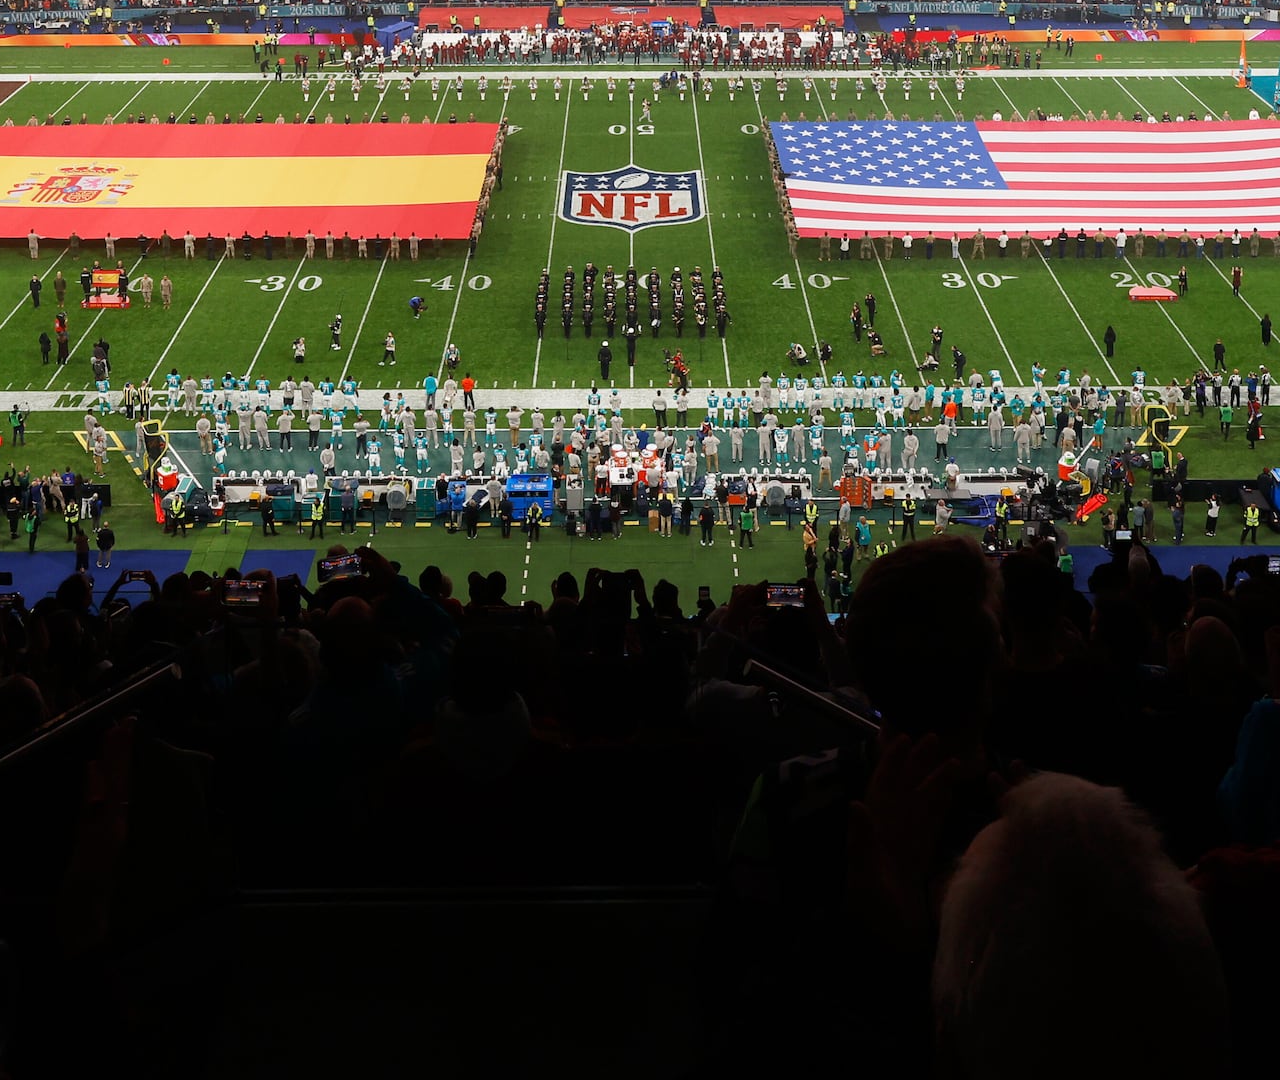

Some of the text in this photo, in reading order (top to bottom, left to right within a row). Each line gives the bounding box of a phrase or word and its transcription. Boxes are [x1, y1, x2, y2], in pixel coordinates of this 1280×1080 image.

[290, 6, 313, 16] 2025
[315, 5, 336, 15] NFL
[894, 3, 912, 12] NFL
[952, 3, 980, 12] GAME
[608, 124, 655, 135] 50
[576, 192, 688, 221] NFL
[260, 275, 323, 292] 30
[430, 275, 493, 291] 40
[771, 273, 833, 290] 40
[942, 272, 1003, 289] 30
[1110, 272, 1172, 288] 20
